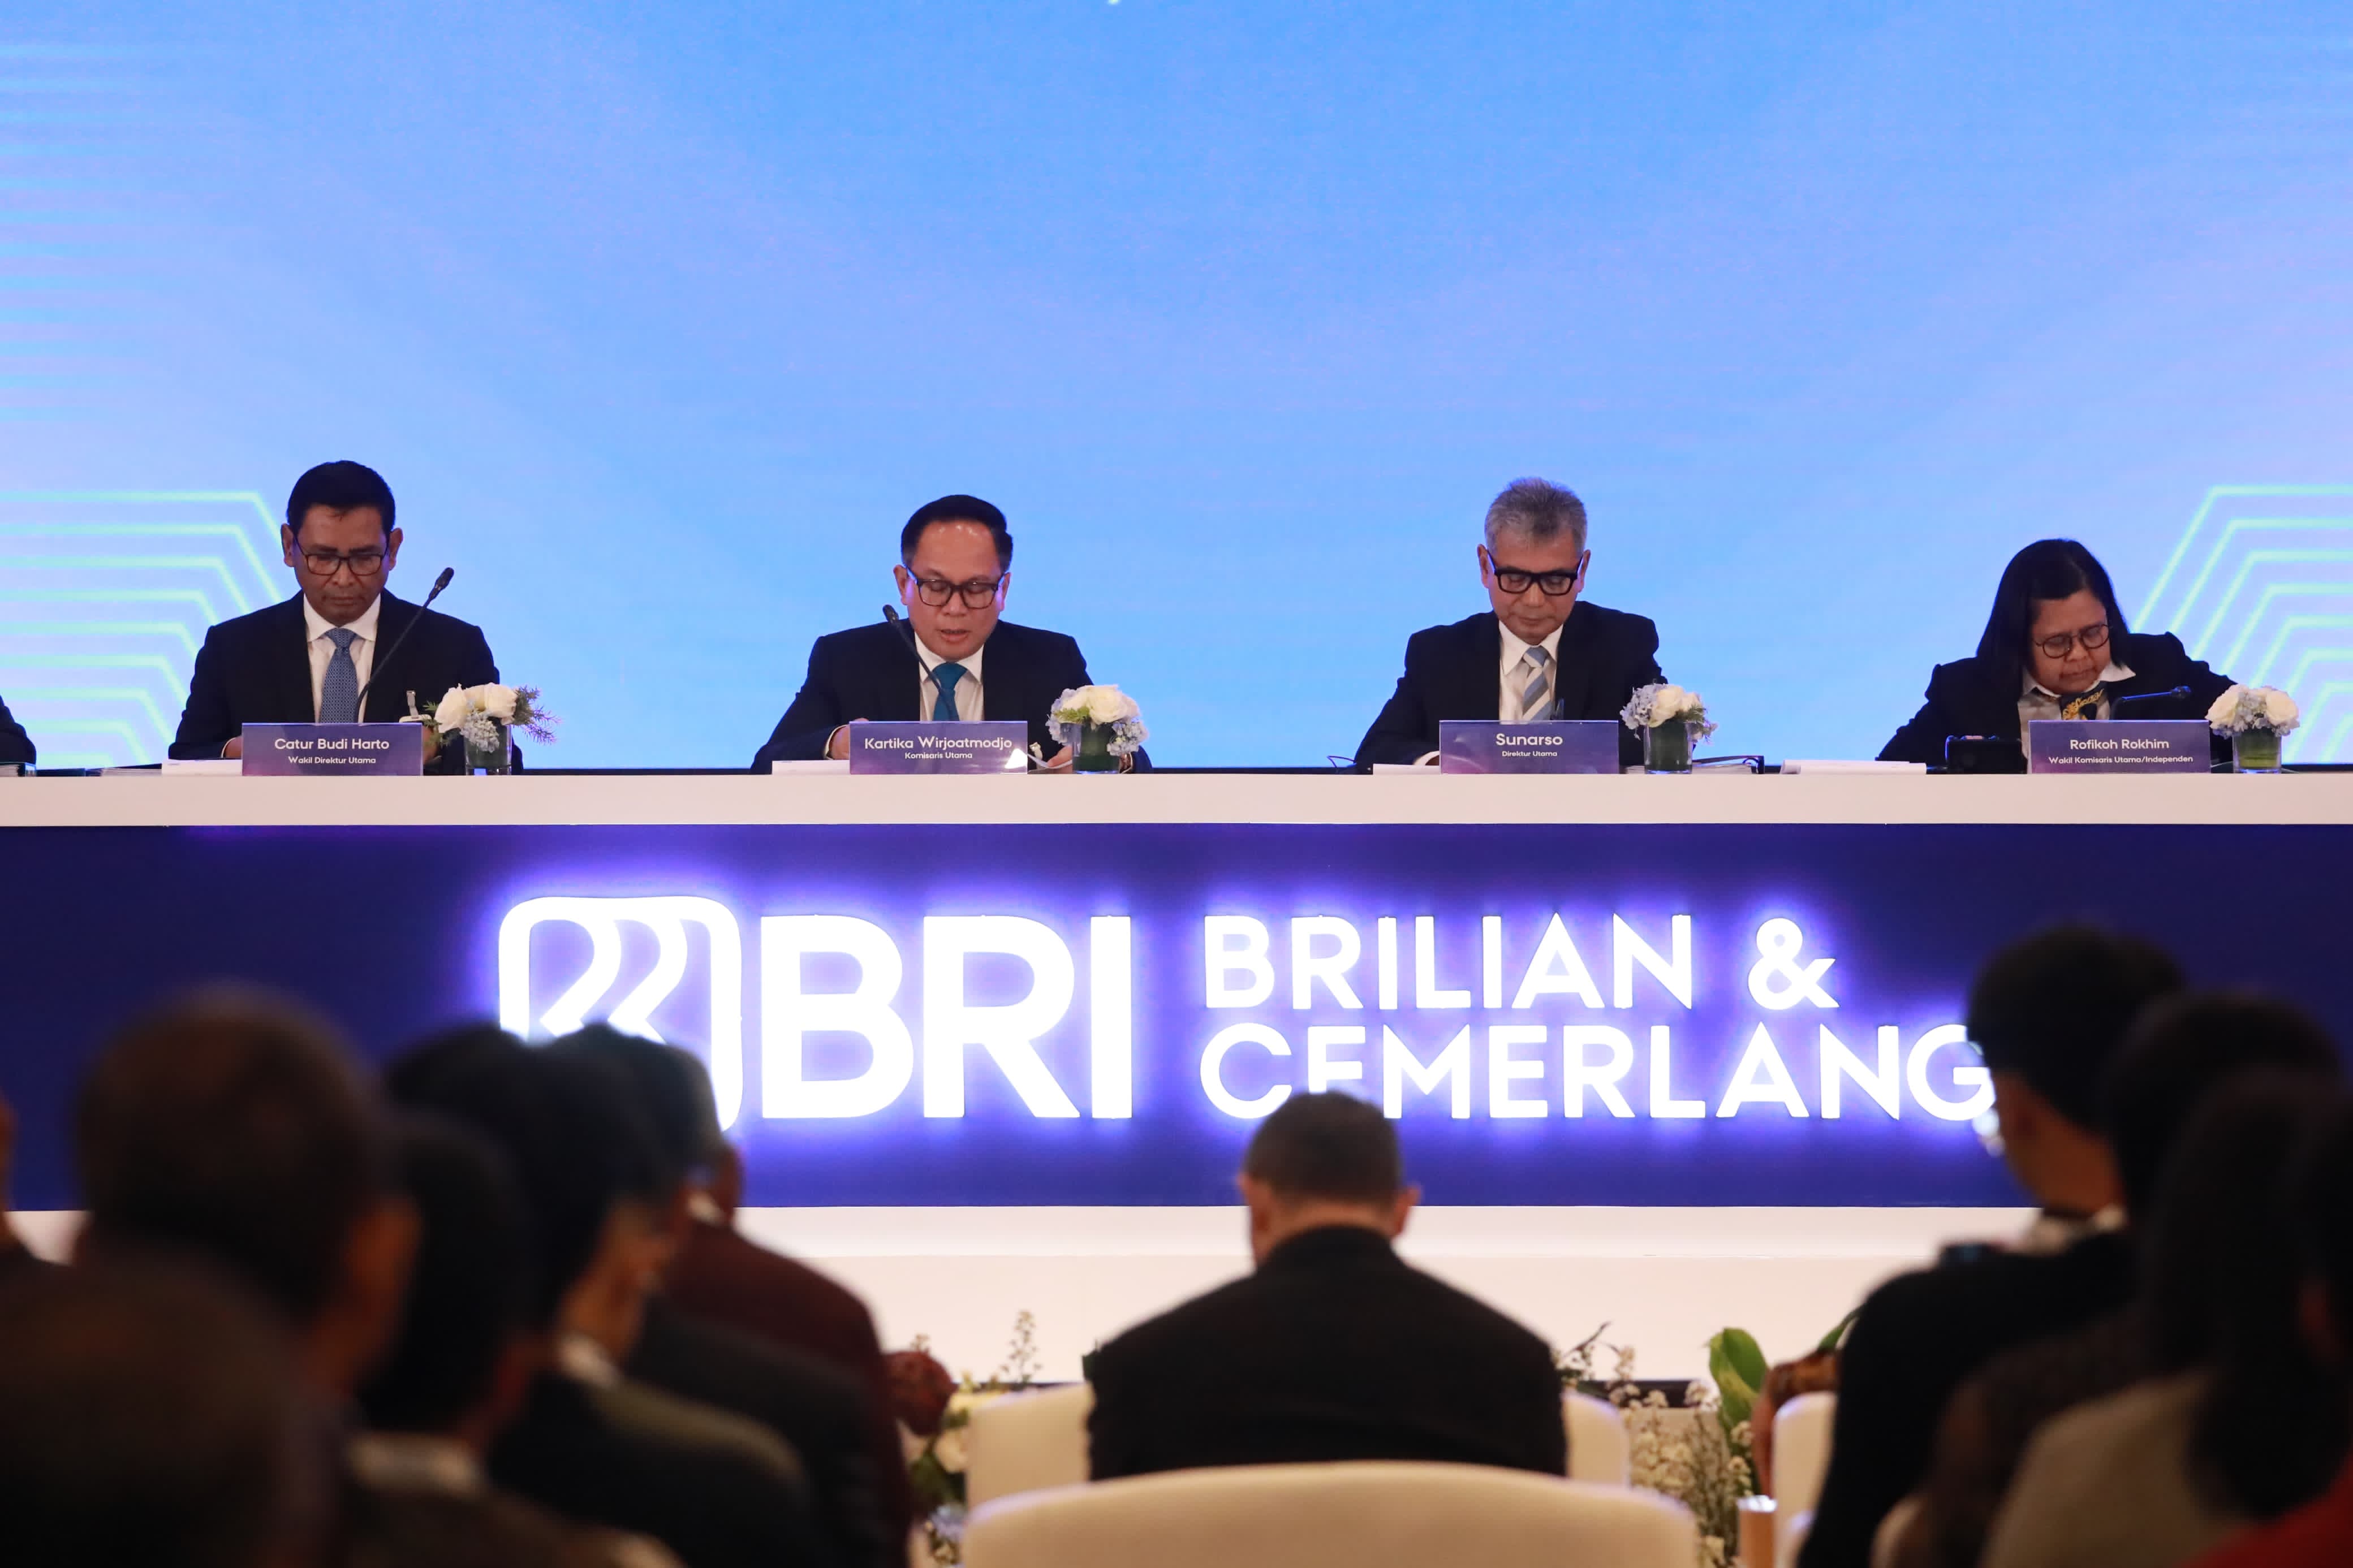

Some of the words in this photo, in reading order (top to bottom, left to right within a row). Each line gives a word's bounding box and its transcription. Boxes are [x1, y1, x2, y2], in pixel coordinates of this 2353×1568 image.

[274, 738, 313, 749] Catur
[317, 738, 348, 749] Budi
[352, 738, 389, 749] Harto
[865, 738, 913, 749] Kartika
[917, 736, 1012, 750] Wirjoatmodjo
[1496, 733, 1563, 745] Sunarso
[2070, 740, 2118, 750] Rofikoh
[2122, 739, 2169, 749] Rokhim
[1204, 913, 1692, 1010] BRILIAN
[1748, 917, 1840, 1010] &
[761, 914, 1132, 1118] BRI
[1200, 1022, 1996, 1121] CEMERLANG
